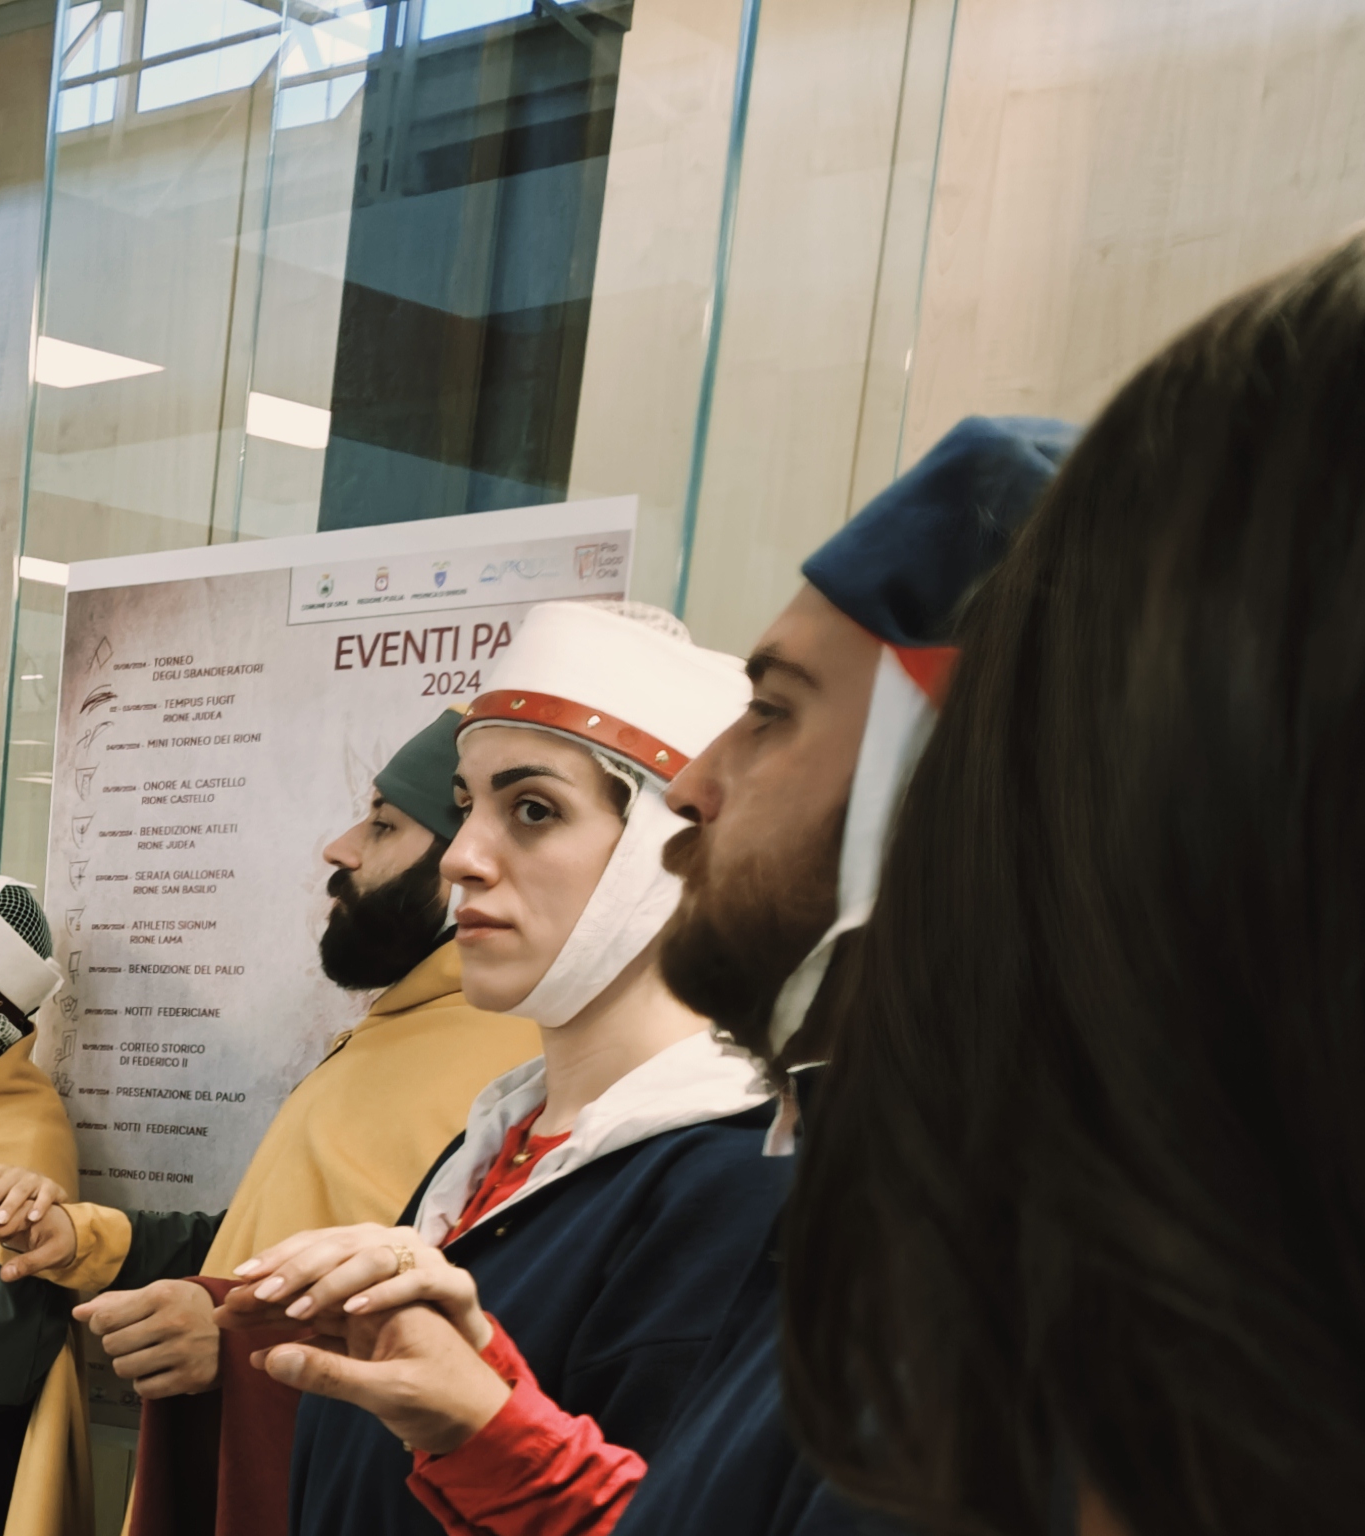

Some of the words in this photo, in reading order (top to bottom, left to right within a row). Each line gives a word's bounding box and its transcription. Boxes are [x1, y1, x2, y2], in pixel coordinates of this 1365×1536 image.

[600, 542, 619, 552] Pro
[597, 556, 624, 567] Loco
[334, 625, 461, 671] EVENTI
[154, 655, 194, 668] TORNEO
[152, 670, 181, 682] DEGLI
[183, 663, 264, 679] SBANDIERATORI
[421, 669, 482, 697] 2024
[164, 696, 204, 710] TEMPUS
[206, 694, 236, 706] FUGIT
[163, 713, 190, 723] RIONE
[192, 711, 222, 722] JUDEA
[147, 738, 168, 749] MINI
[171, 736, 211, 748] TORNEO
[213, 734, 231, 745] DEI
[232, 732, 262, 744] RIONI
[143, 780, 177, 791] ONORE
[180, 779, 192, 790] AL
[195, 777, 246, 789] CASTELLO
[141, 796, 168, 805] RIONE
[170, 794, 215, 804] CASTELLO
[139, 825, 203, 837] BENEDIZIONE
[205, 823, 238, 834] ATLETI
[137, 841, 164, 850] RIONE
[166, 840, 196, 850] JUDEA
[134, 871, 170, 881] SERATA
[173, 869, 235, 880] GIALLONERA
[133, 885, 159, 895] RIONE
[161, 885, 180, 895] SAN
[182, 884, 217, 894] BASILIO
[131, 920, 176, 930] ATHLETIS
[177, 920, 217, 930] SIGNUM
[129, 935, 156, 944] RIONE
[158, 935, 183, 944] LAMA
[128, 964, 191, 975] BENEDIZIONE
[194, 965, 211, 975] DEL
[214, 965, 245, 976] PALIO
[124, 1006, 152, 1017] NOTTI
[157, 1007, 221, 1018] FEDERICIANE
[120, 1042, 159, 1053] CORTEO
[161, 1043, 206, 1054] STORICO
[120, 1056, 129, 1065] DI
[132, 1056, 180, 1067] FEDERICO
[181, 1058, 188, 1068] II
[115, 1086, 192, 1100] PRESENTAZIONE
[194, 1090, 213, 1101] DEL
[215, 1092, 246, 1103] PALIO
[113, 1121, 141, 1133] NOTTI
[145, 1123, 209, 1137] FEDERICIANE
[108, 1167, 146, 1180] TORNEO
[148, 1170, 164, 1182] DEI
[166, 1172, 194, 1184] RIONI
